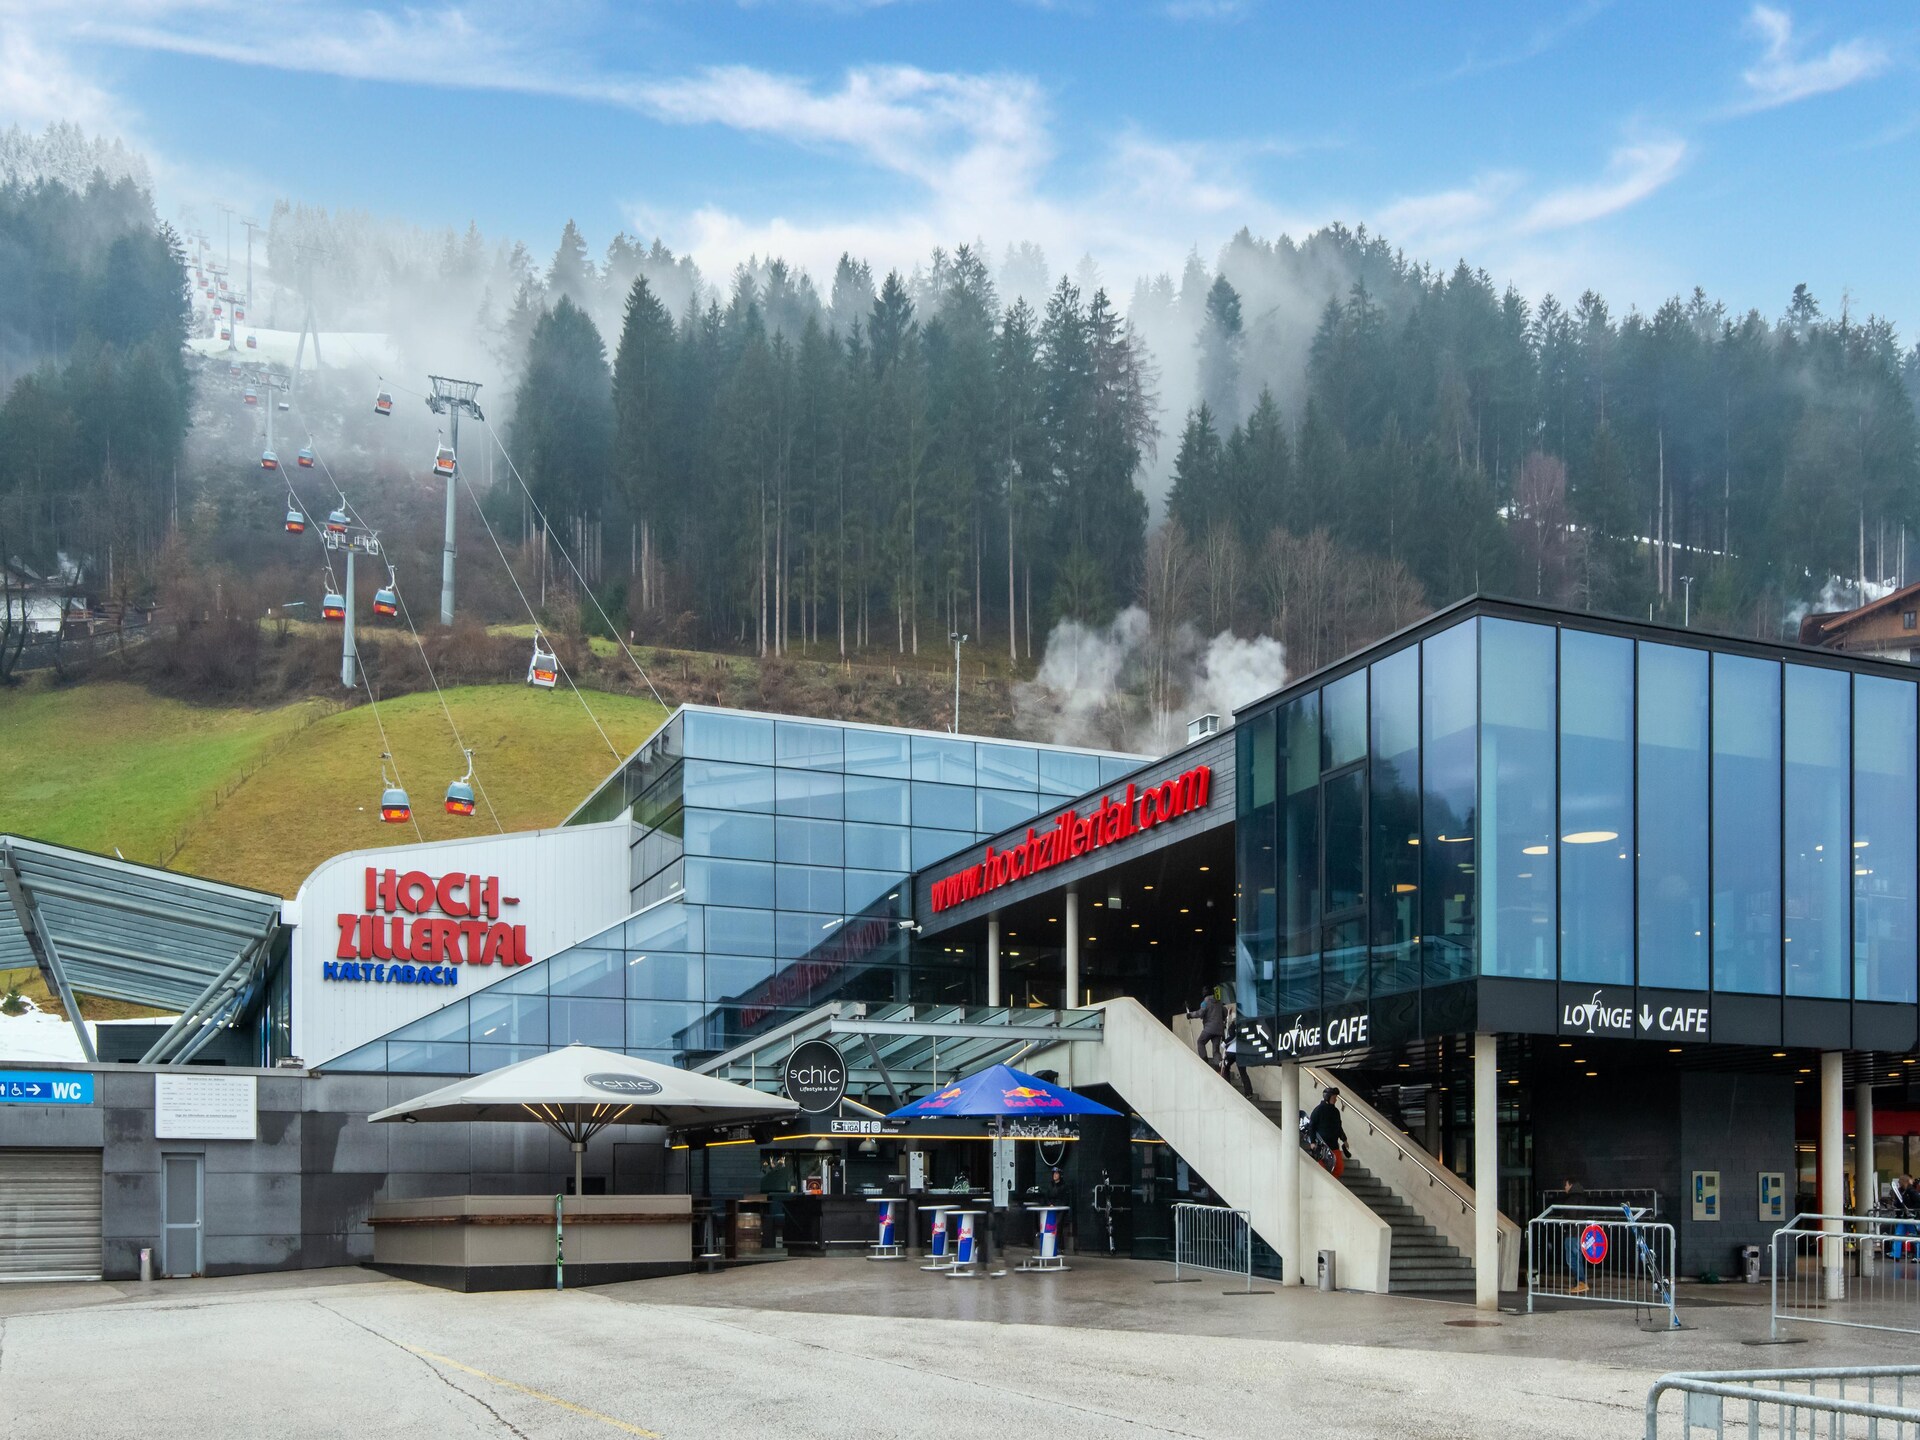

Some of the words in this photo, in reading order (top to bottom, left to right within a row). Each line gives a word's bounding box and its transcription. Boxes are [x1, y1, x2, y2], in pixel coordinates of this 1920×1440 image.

[931, 765, 1211, 912] www.hochzillertal.com
[365, 867, 521, 919] HOCH-
[336, 913, 533, 966] ZILLERTAL
[323, 960, 458, 985] KALTENBACH
[1327, 1015, 1368, 1046] CAFE
[1659, 1006, 1708, 1033] CAFE
[52, 1082, 82, 1100] WC
[843, 1124, 859, 1132] LIGA
